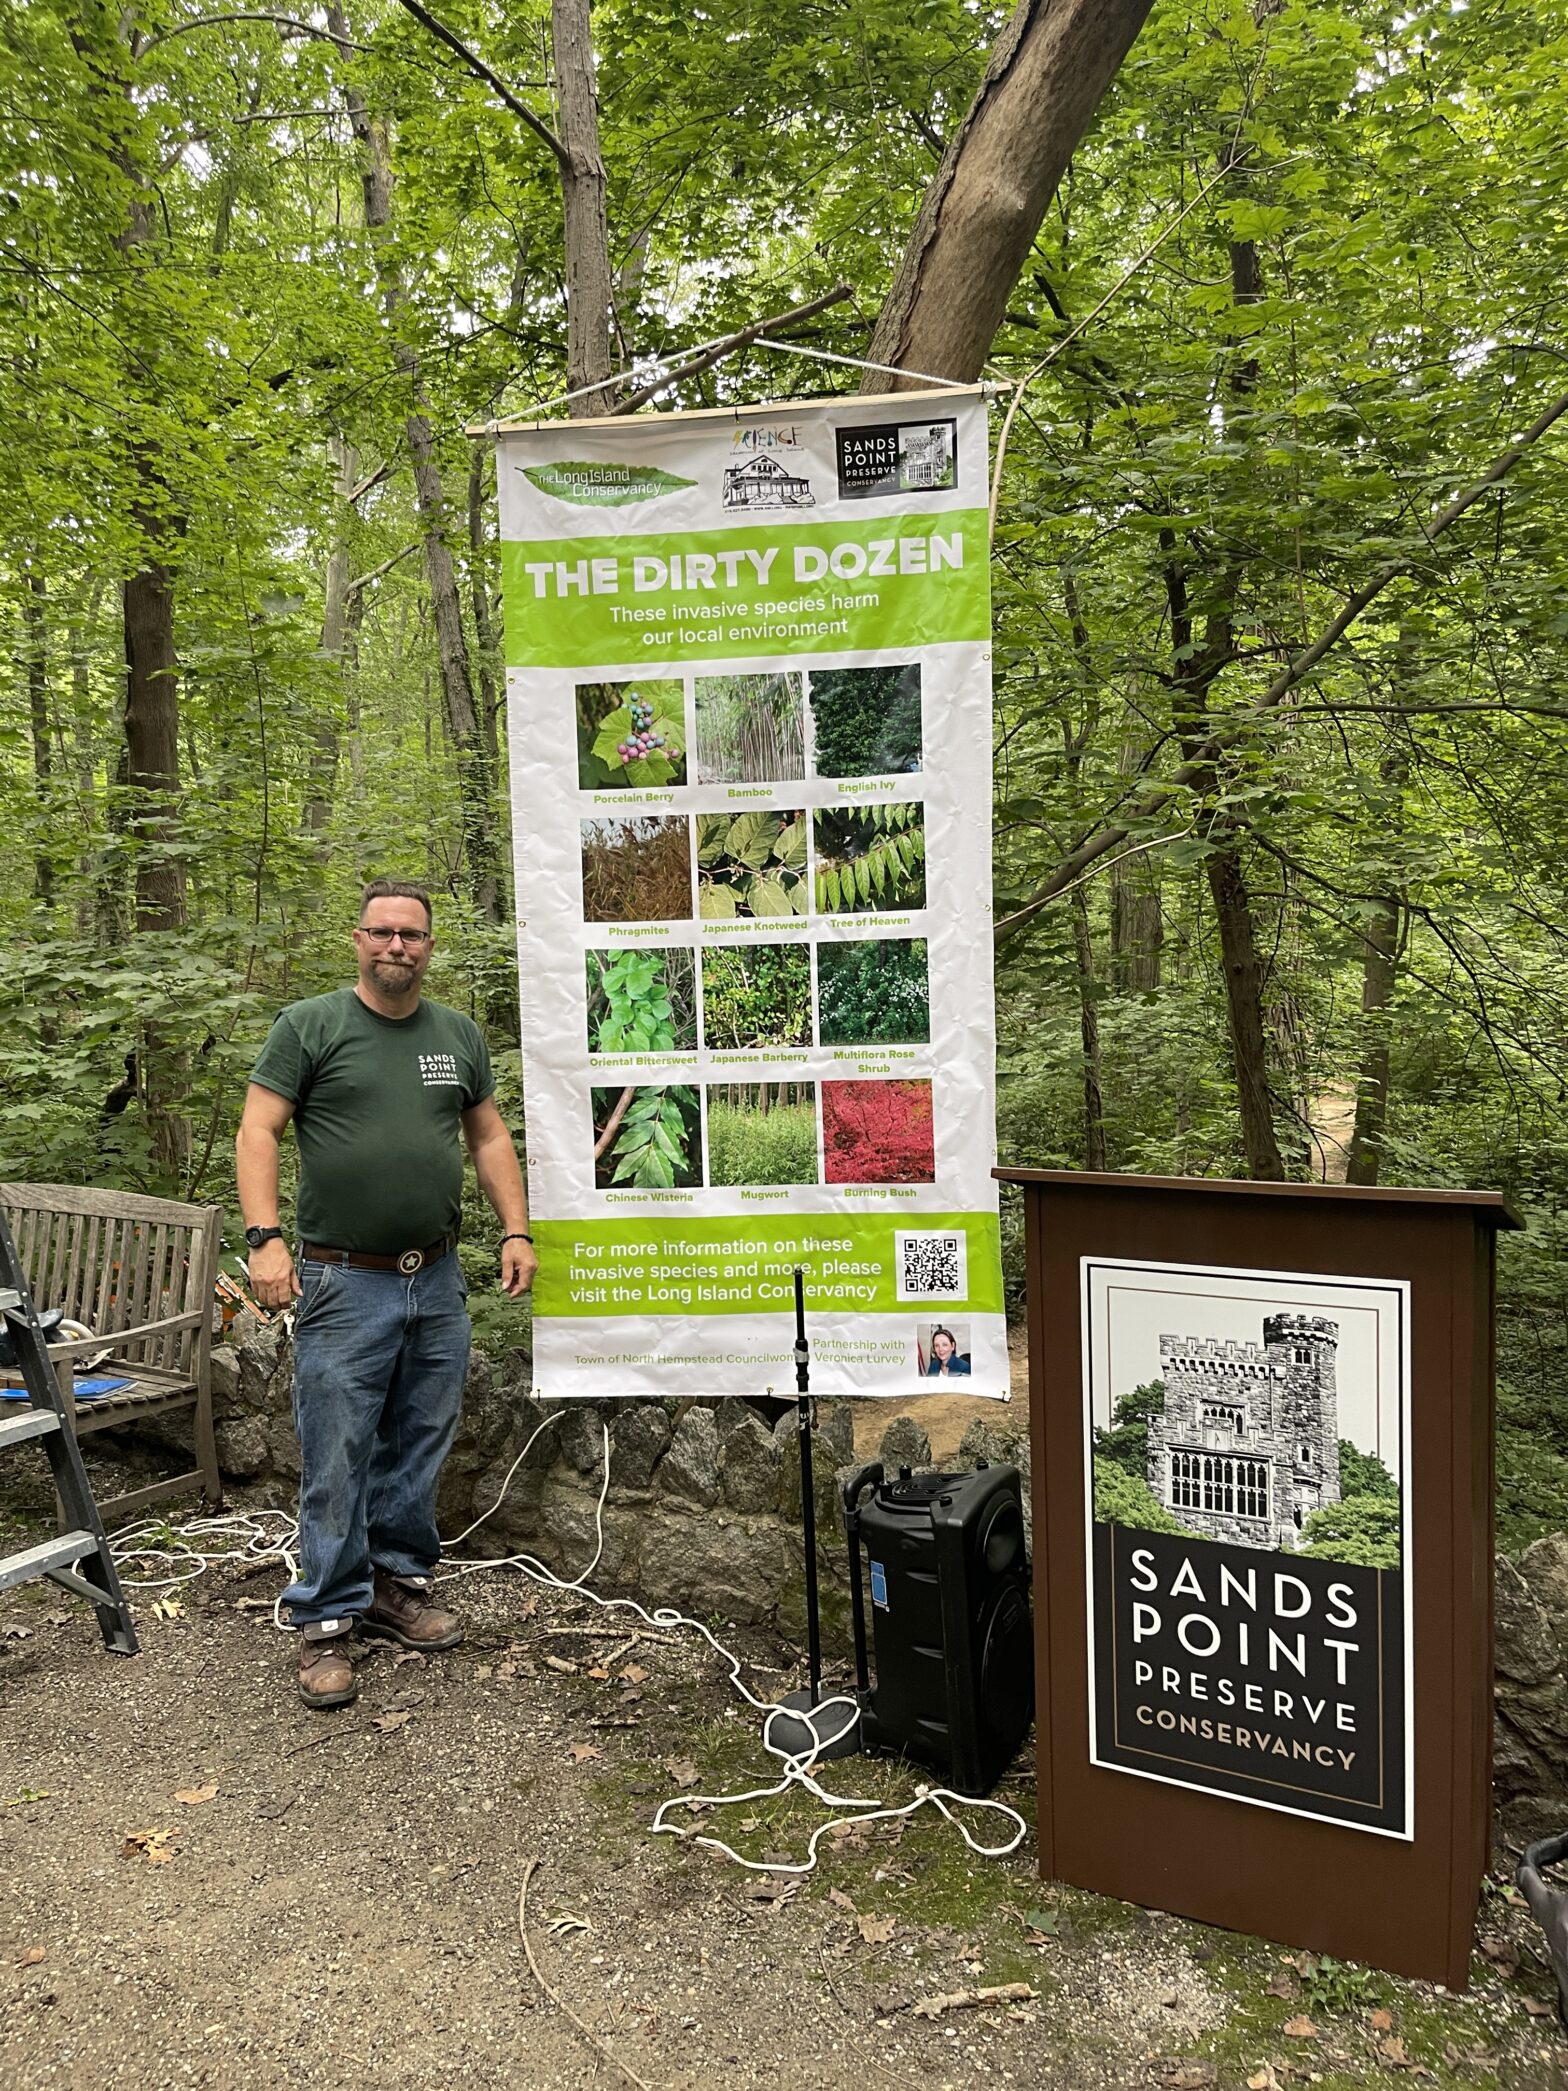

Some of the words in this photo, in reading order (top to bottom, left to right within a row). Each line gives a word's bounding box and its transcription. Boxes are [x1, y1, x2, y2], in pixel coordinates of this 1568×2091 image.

[843, 438, 897, 453] SANDS
[844, 452, 897, 467] POINT
[845, 466, 897, 477] PRESERVE
[572, 482, 663, 498] Conservancy
[525, 557, 619, 598] THE
[633, 547, 780, 592] DIRTY
[793, 532, 964, 583] DOZEN
[609, 606, 667, 623] These
[672, 601, 749, 620] invasive
[754, 596, 826, 618] species
[831, 593, 880, 610] harm
[642, 631, 674, 645] our
[679, 625, 723, 644] local
[728, 618, 849, 640] environment
[727, 788, 773, 798] Bamboo
[837, 783, 877, 794] English
[880, 780, 896, 791] Ivy
[593, 793, 642, 804] Porcelain
[645, 792, 674, 803] Berry
[702, 924, 751, 935] Japanese
[754, 920, 808, 931] Knotweed
[830, 919, 854, 928] Tree
[856, 917, 868, 927] of
[869, 917, 911, 926] Heaven
[608, 926, 670, 938] Phragmites
[418, 1054, 456, 1064] SANDS
[589, 1057, 633, 1067] Oriental
[636, 1055, 698, 1065] Bittersweet
[710, 1054, 760, 1065] Japanese
[762, 1053, 808, 1063] Barberry
[833, 1050, 886, 1060] Multiflora
[888, 1049, 915, 1059] Rose
[420, 1063, 457, 1072] POINT
[858, 1064, 891, 1073] Shrub
[605, 1193, 648, 1202] Chinese
[650, 1192, 694, 1202] Wisteria
[741, 1190, 789, 1200] Mugwort
[844, 1187, 887, 1198] Burning
[889, 1187, 917, 1197] Bush
[574, 1243, 605, 1258] For
[610, 1242, 658, 1257] more
[663, 1239, 768, 1256] information
[773, 1240, 797, 1254] on
[802, 1236, 854, 1252] these
[569, 1264, 645, 1281] invasive
[650, 1263, 718, 1281] species
[723, 1261, 758, 1278] and
[822, 1258, 882, 1278] please
[570, 1287, 607, 1303] visit
[613, 1286, 642, 1301] the
[648, 1284, 692, 1304] Long
[698, 1284, 752, 1300] Island
[757, 1282, 877, 1302] Conervancy
[812, 1338, 878, 1351] Partnership
[880, 1338, 905, 1350] with
[574, 1355, 605, 1365] Town
[608, 1354, 620, 1365] of
[622, 1354, 654, 1364] North
[657, 1354, 723, 1366] Hempstead
[726, 1353, 797, 1364] Councilwom
[814, 1351, 863, 1364] Veronica
[866, 1352, 906, 1366] Lurvey
[1129, 1549, 1358, 1629] SANDS
[1131, 1601, 1360, 1686] POINT
[1135, 1659, 1357, 1733] PRESERVE
[1136, 1705, 1357, 1771] CONSERVANCY
